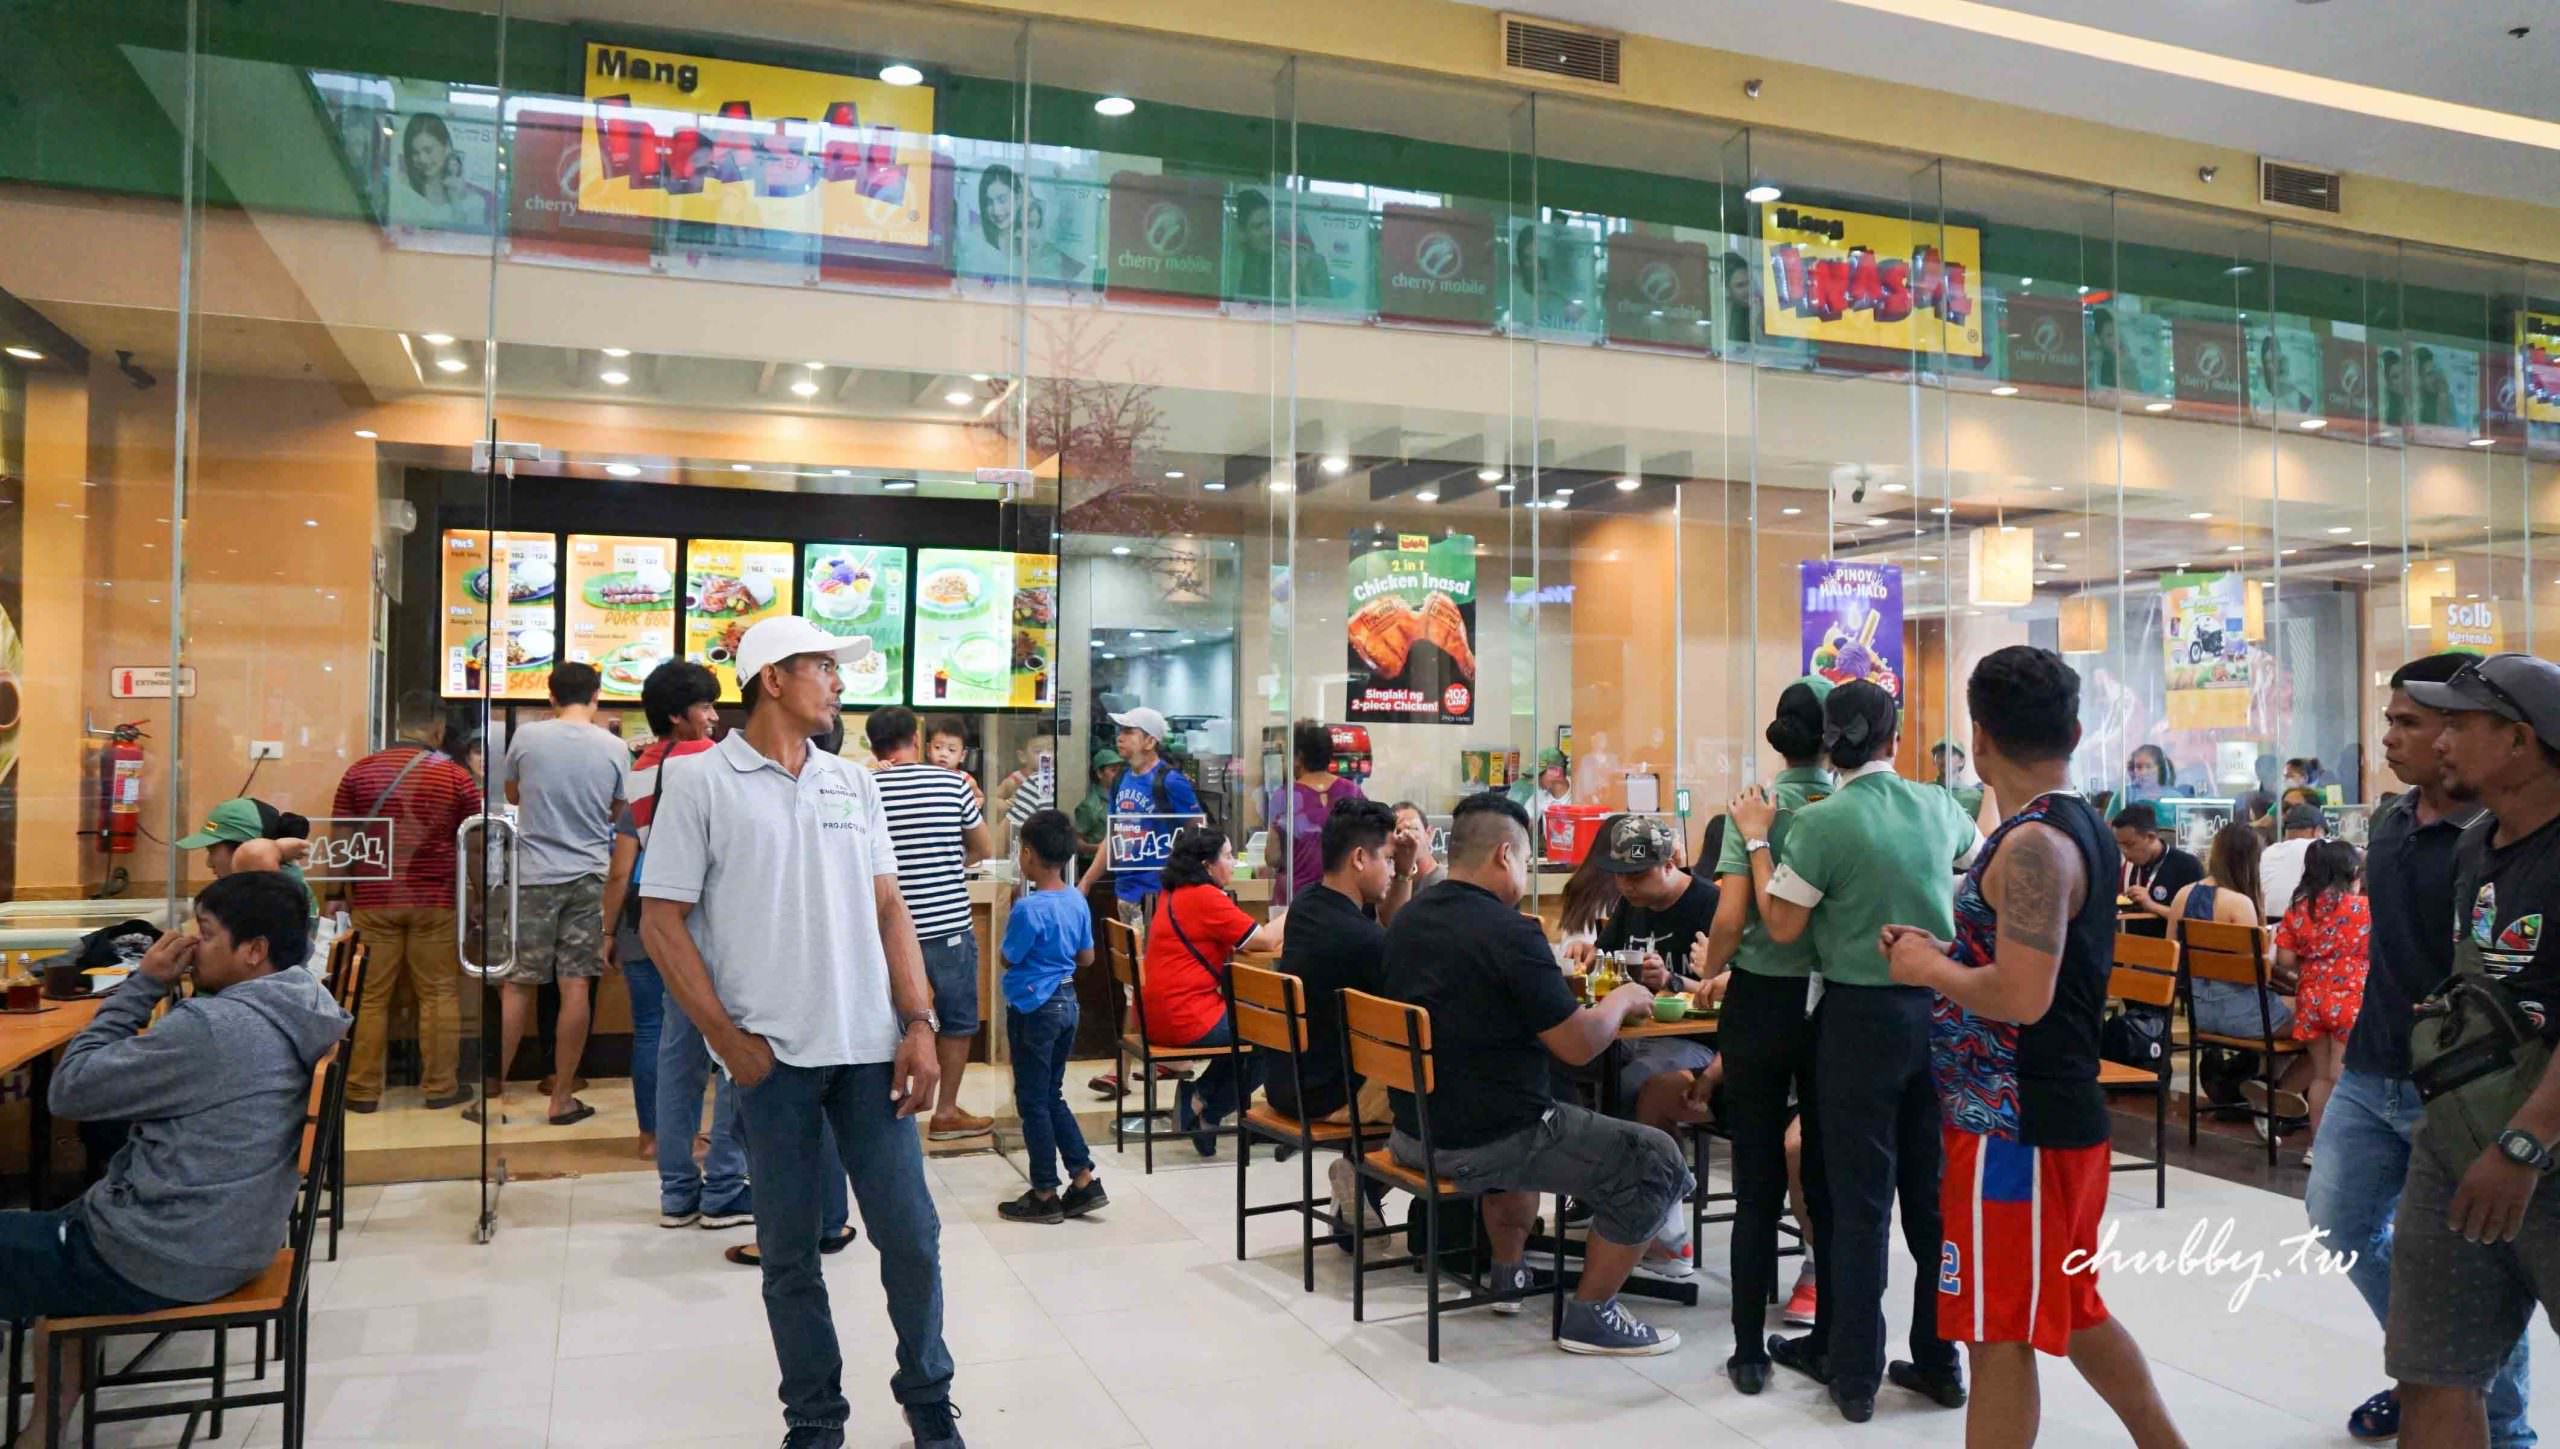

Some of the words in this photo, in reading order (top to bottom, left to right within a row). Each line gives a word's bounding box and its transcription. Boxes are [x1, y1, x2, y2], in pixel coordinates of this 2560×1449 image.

[597, 49, 698, 93] Mang
[524, 195, 577, 216] cherry
[1118, 250, 1161, 273] cherry
[1391, 272, 1436, 295] cherry
[1439, 277, 1488, 296] mobile
[1391, 560, 1400, 572] 2
[1403, 559, 1416, 571] in
[1837, 568, 1872, 581] PINOY
[1353, 573, 1418, 601] Chicken
[1422, 571, 1471, 596] Inasal
[1820, 583, 1887, 599] HALO-HALO
[1365, 688, 1408, 701] Singlaki
[1409, 691, 1424, 702] ng
[1351, 699, 1392, 712] 2-piece
[1393, 700, 1439, 713] Chicken!
[1113, 823, 1141, 832] Mang
[304, 832, 384, 869] ASAL
[1112, 828, 1184, 862] INAS
